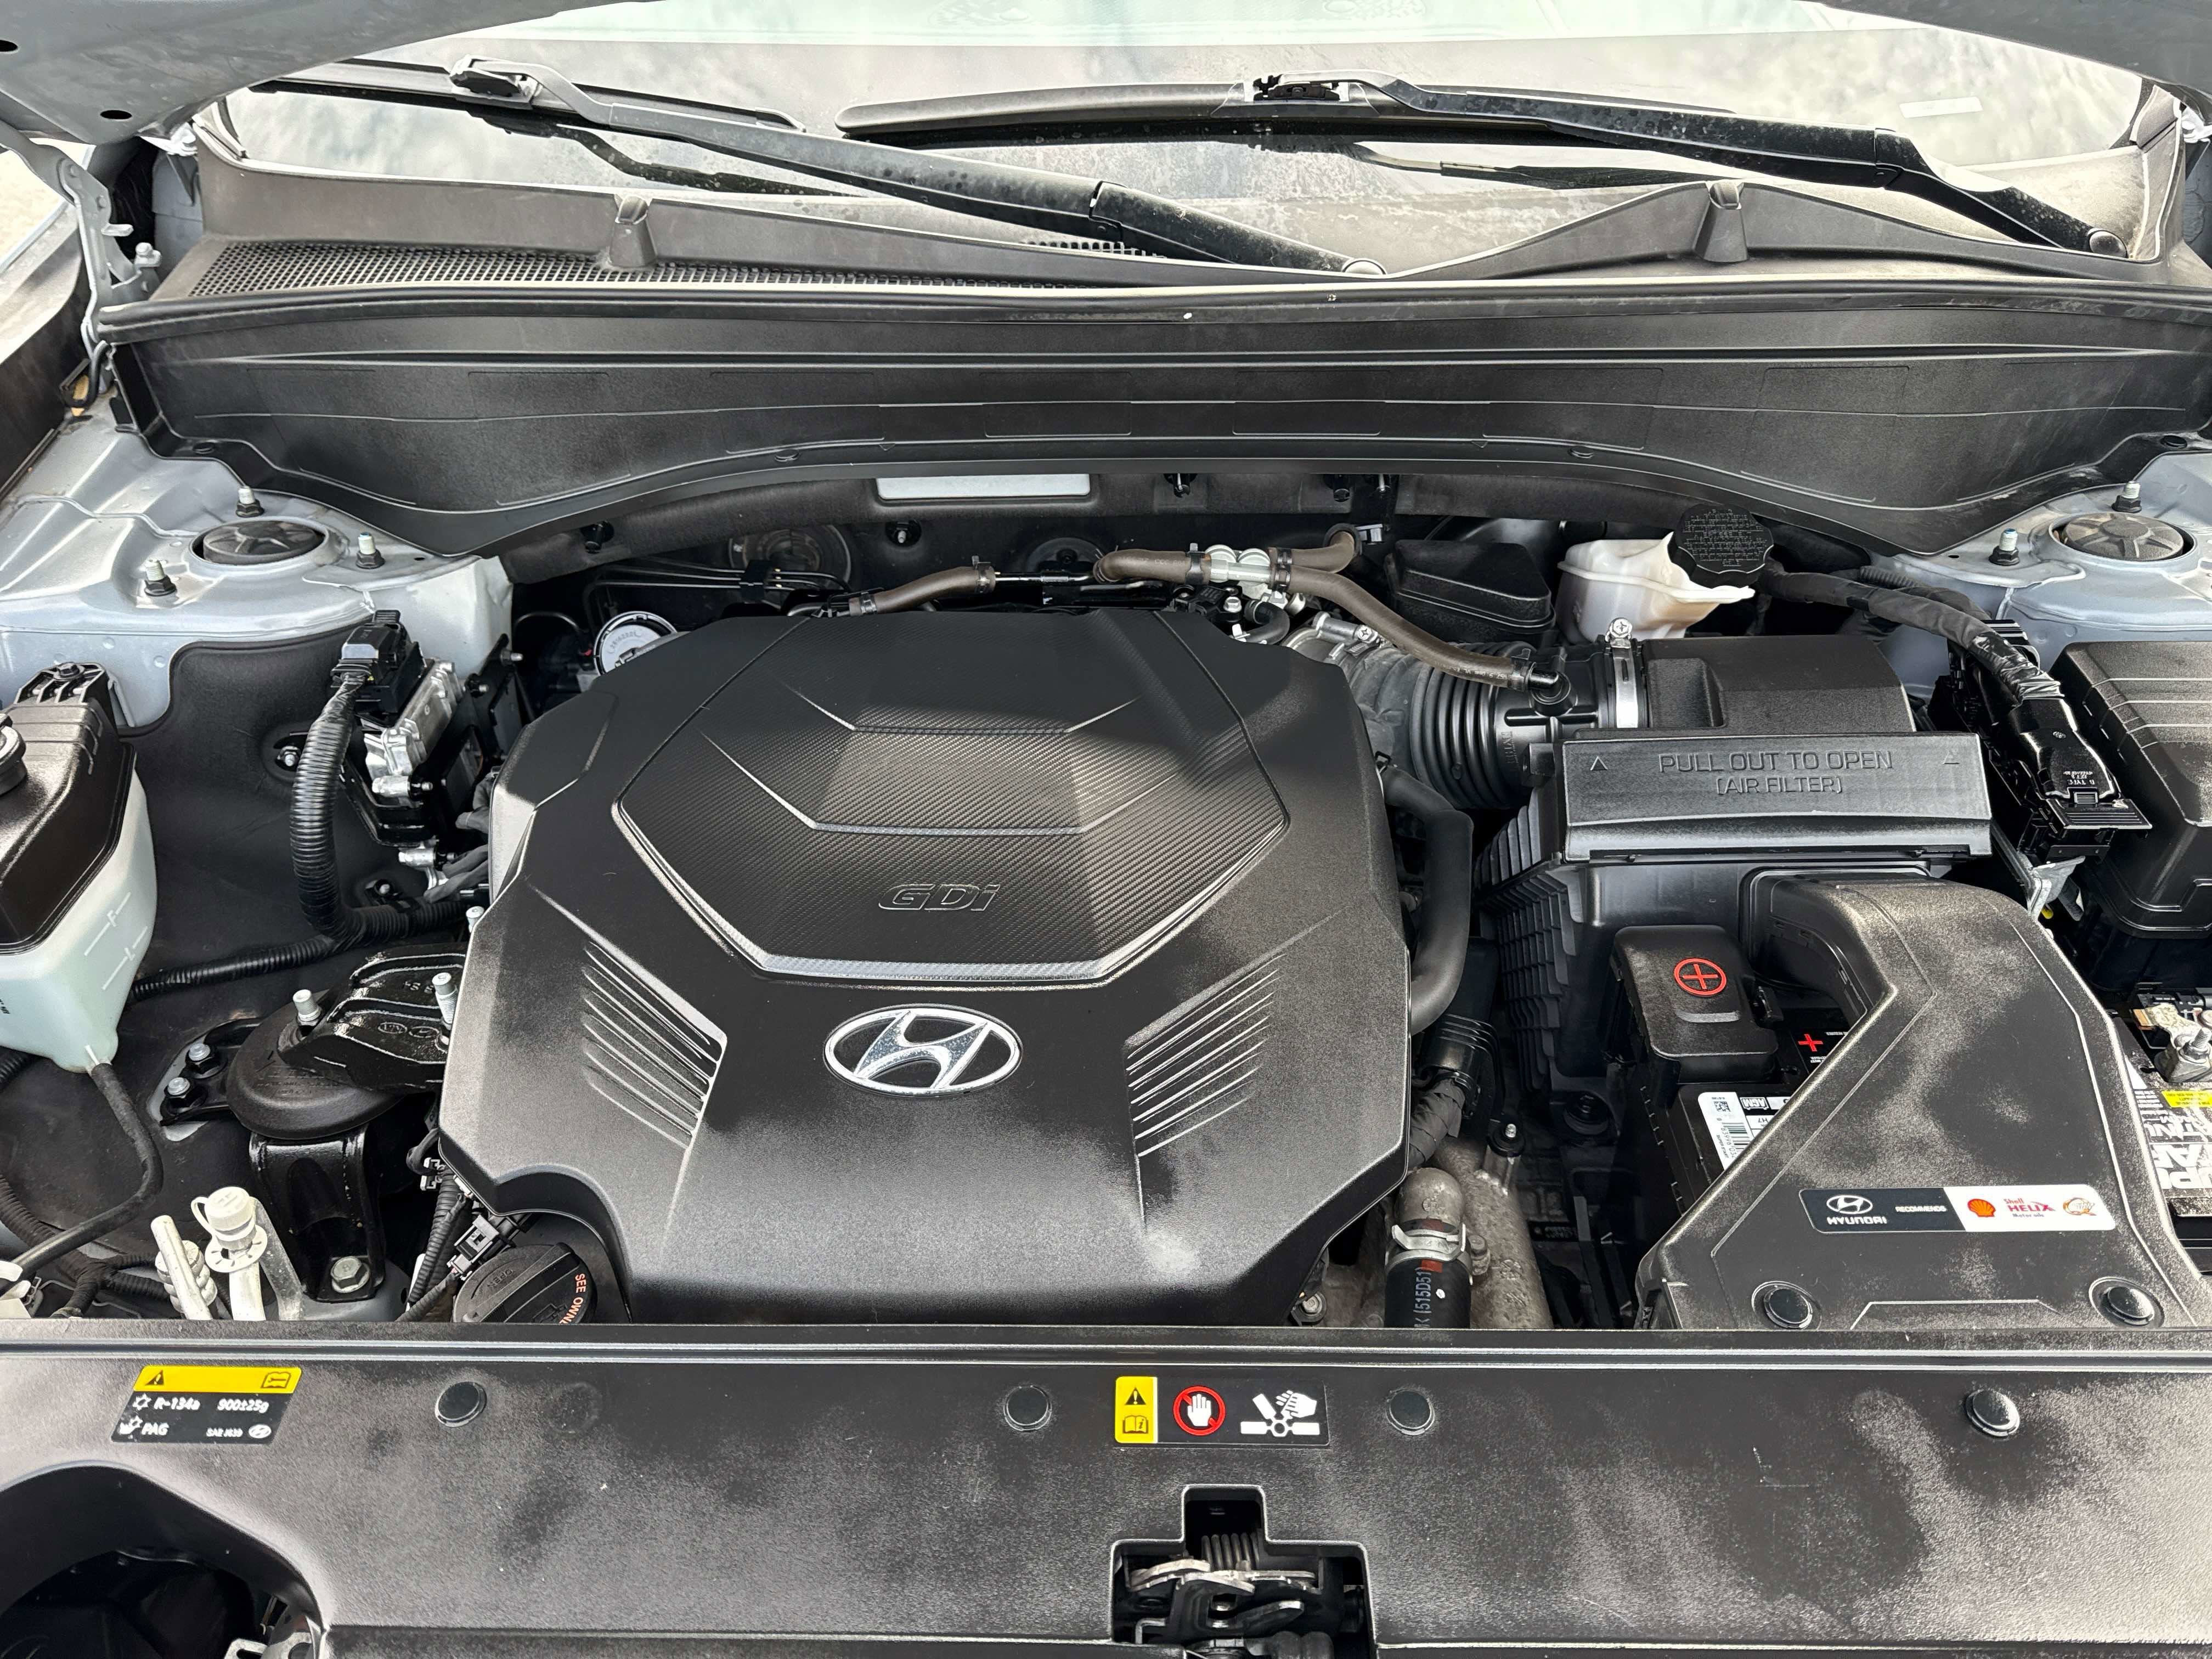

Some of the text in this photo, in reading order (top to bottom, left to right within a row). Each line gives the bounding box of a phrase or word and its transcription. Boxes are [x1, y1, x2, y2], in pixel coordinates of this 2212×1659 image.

[1658, 750, 1892, 773] PULL OUT TO OPEN
[1742, 1098, 1765, 1108] AGM
[2007, 1203, 2056, 1212] HELIX
[1826, 1216, 1888, 1224] HYUNDAI
[575, 1273, 586, 1293] SEE
[154, 1397, 200, 1410] R-134a
[141, 1423, 169, 1436] PAG
